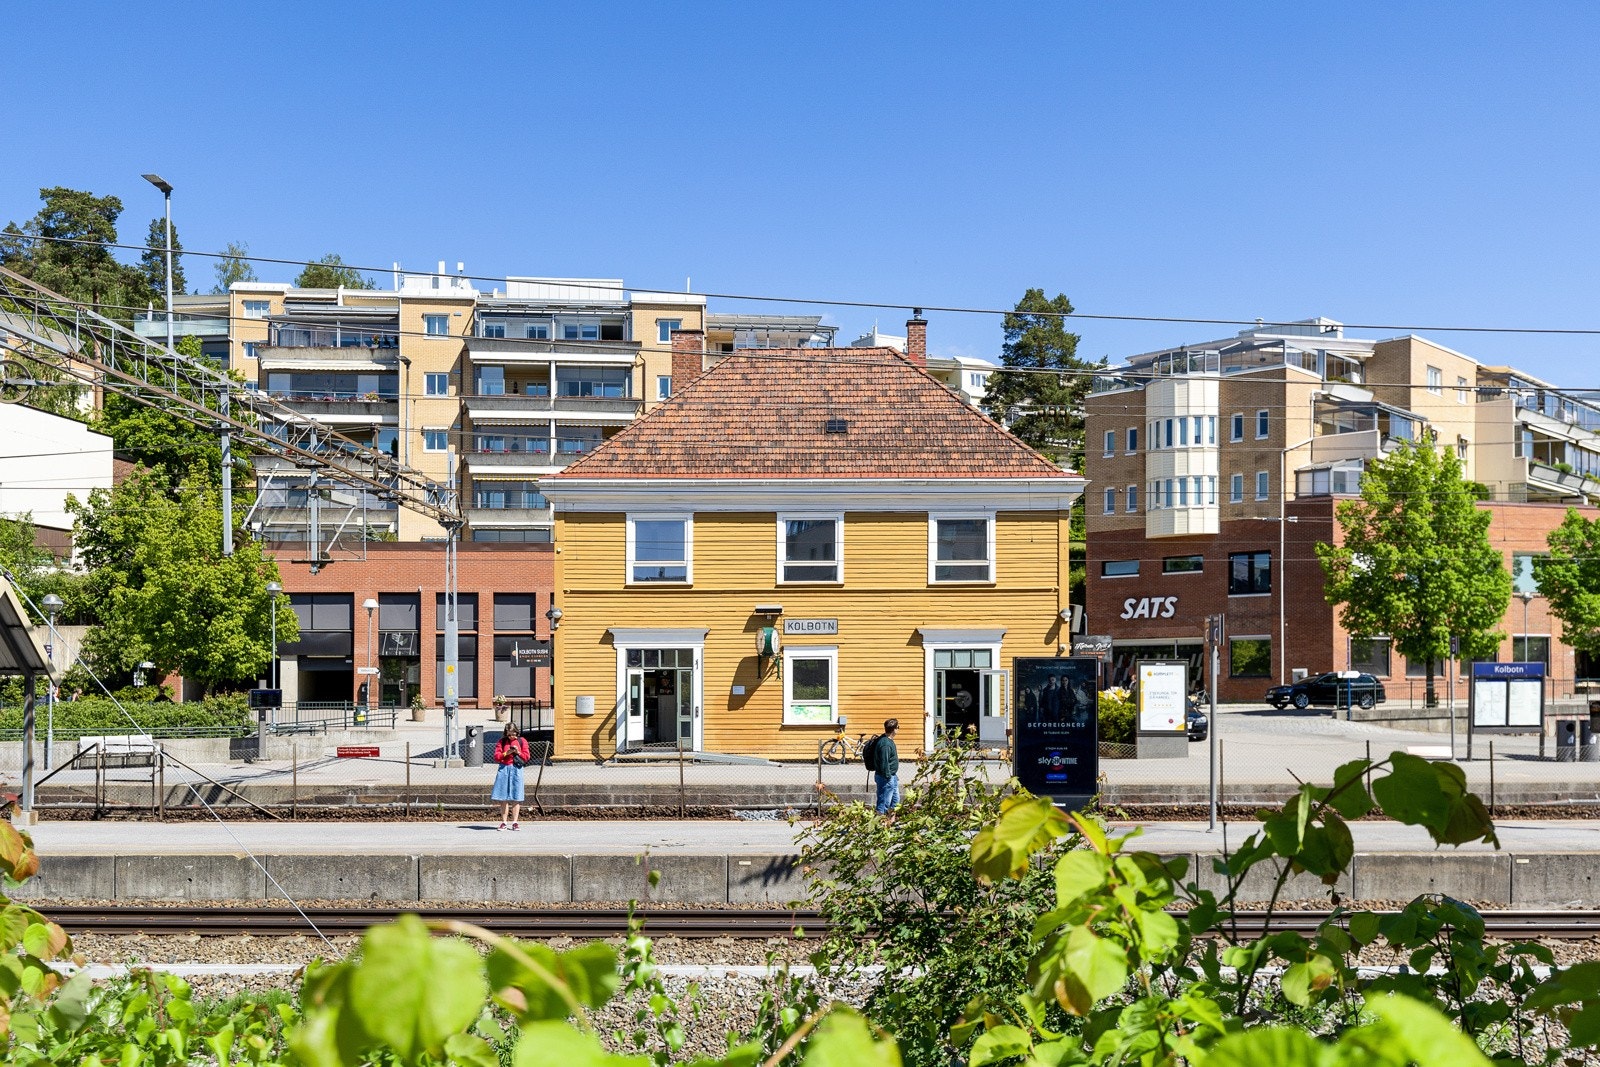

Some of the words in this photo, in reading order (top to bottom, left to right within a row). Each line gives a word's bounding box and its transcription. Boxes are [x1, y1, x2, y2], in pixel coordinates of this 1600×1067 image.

[1120, 596, 1178, 619] SATS
[787, 622, 834, 631] KOLBOTN
[1494, 665, 1524, 673] Kolbotn
